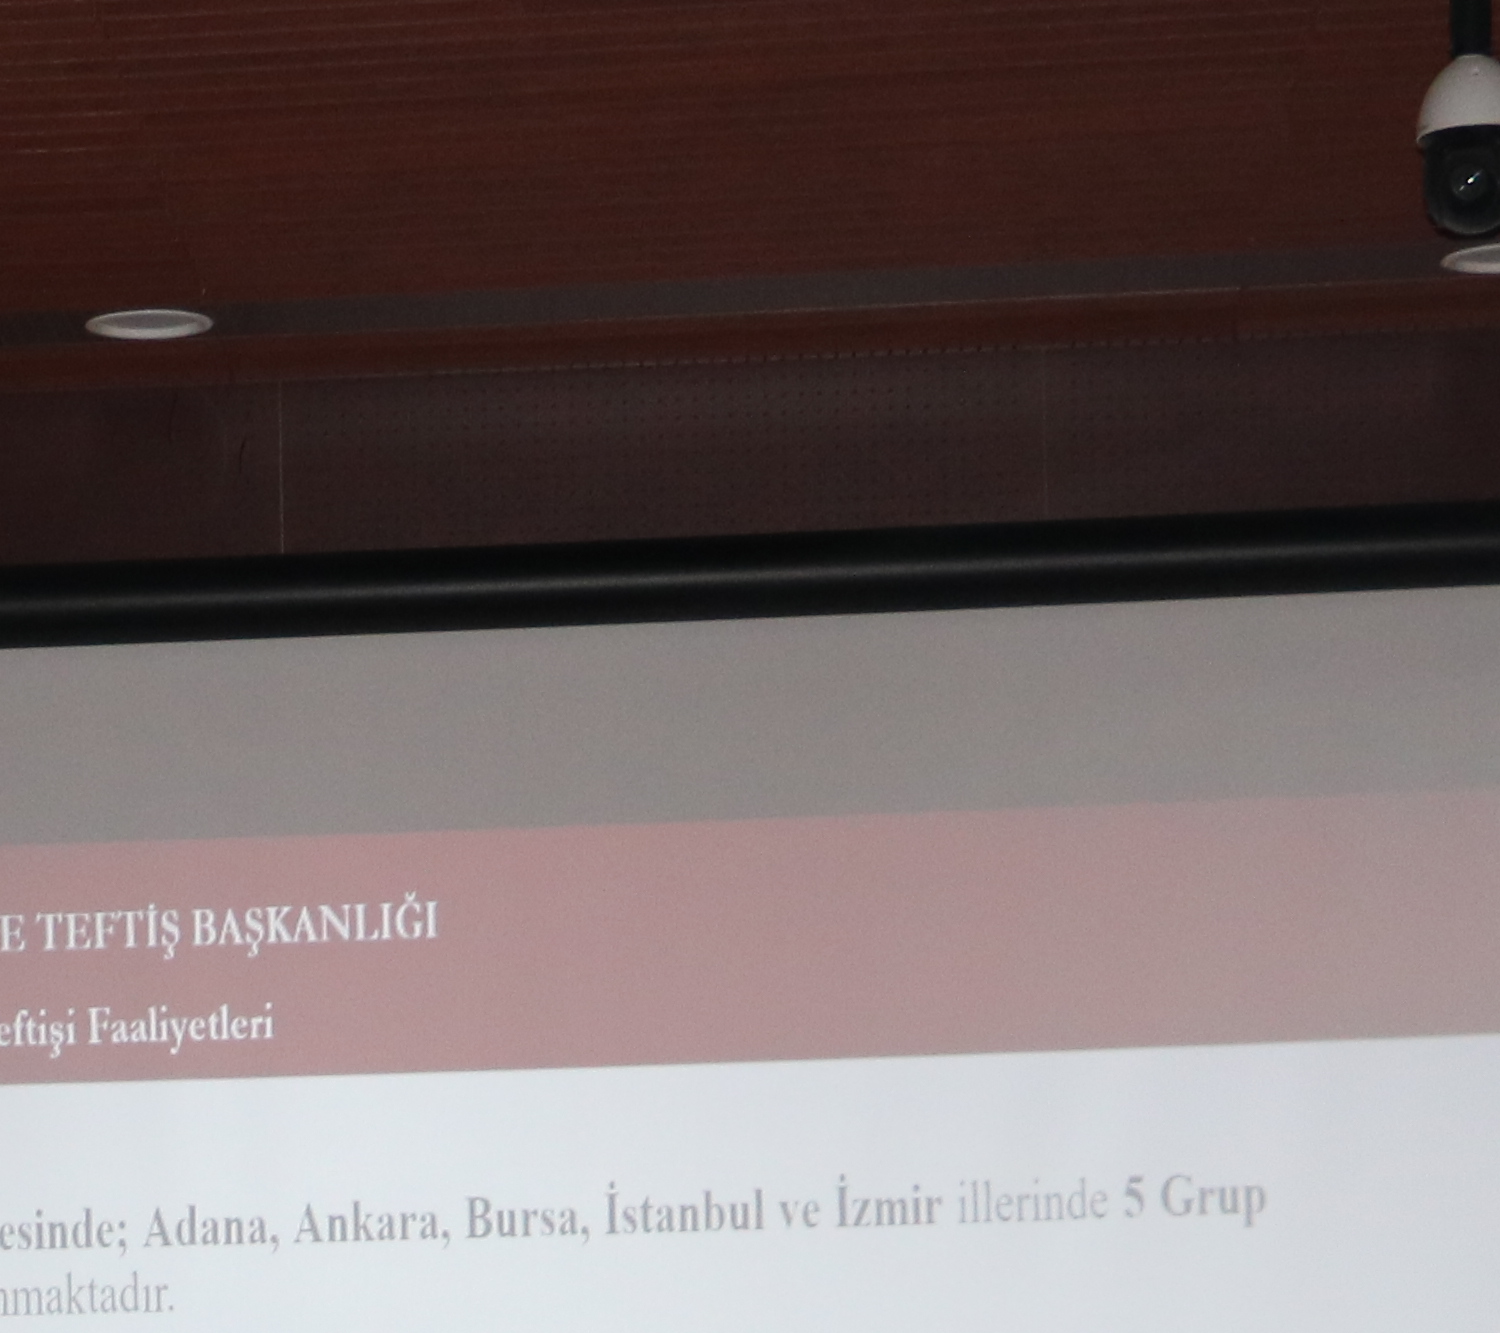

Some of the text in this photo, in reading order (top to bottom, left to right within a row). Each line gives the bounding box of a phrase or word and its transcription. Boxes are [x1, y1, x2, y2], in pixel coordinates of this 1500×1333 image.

[34, 903, 180, 960] TEFTİŞ
[192, 890, 439, 958] BAŞKANLIĞI
[87, 1001, 275, 1055] Faaliyetleri
[142, 1204, 282, 1254] Adana,
[293, 1200, 452, 1249] Ankara,
[463, 1196, 591, 1241] Bursa,
[604, 1180, 765, 1237] İstanbul
[778, 1198, 822, 1230] ve
[835, 1173, 945, 1228] İzmir
[956, 1177, 1110, 1226] illerinde
[1121, 1174, 1147, 1217] 5
[1159, 1173, 1268, 1227] Grup
